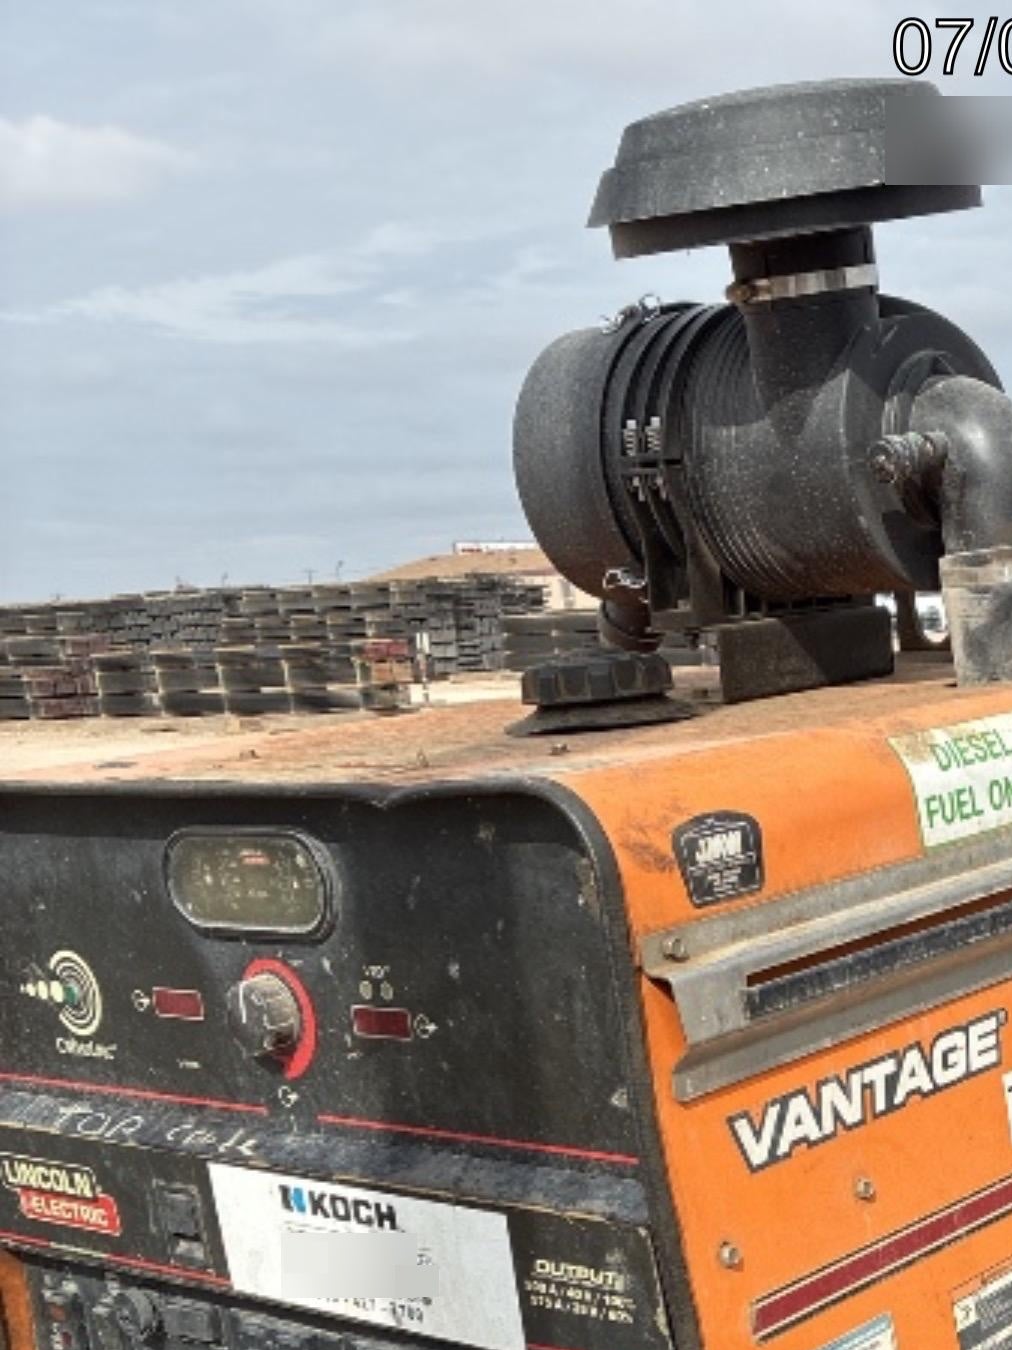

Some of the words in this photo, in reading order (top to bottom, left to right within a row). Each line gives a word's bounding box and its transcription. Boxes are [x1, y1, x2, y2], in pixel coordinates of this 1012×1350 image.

[924, 786, 984, 829] FUEL
[727, 1012, 1004, 1173] VANTAGE
[3, 1160, 94, 1199] LINCOLN
[31, 1197, 109, 1227] ELECTRIC
[307, 1190, 398, 1230] KOCH
